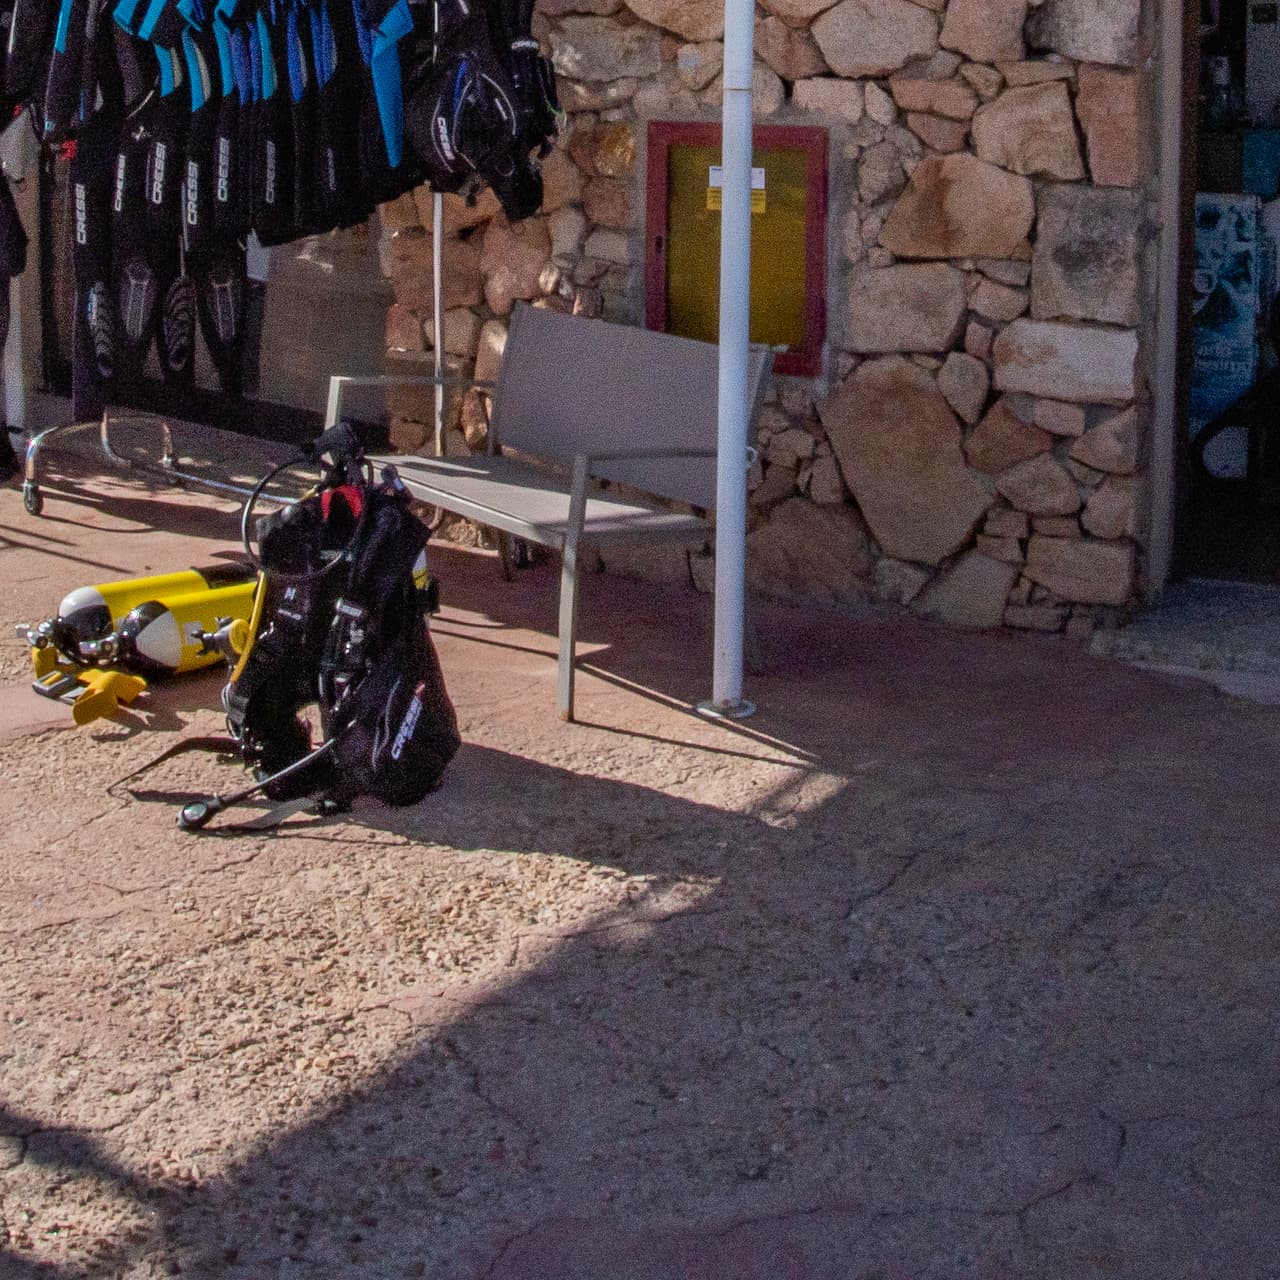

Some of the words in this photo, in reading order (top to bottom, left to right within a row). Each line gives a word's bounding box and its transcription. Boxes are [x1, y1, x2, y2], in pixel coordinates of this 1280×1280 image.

[114, 154, 127, 212] CRESSI
[152, 141, 167, 205] CRESSI
[187, 160, 199, 226] CRESSI
[217, 136, 230, 203] CRESSI
[265, 140, 276, 204] CRESSI
[74, 183, 87, 245] CRESSI
